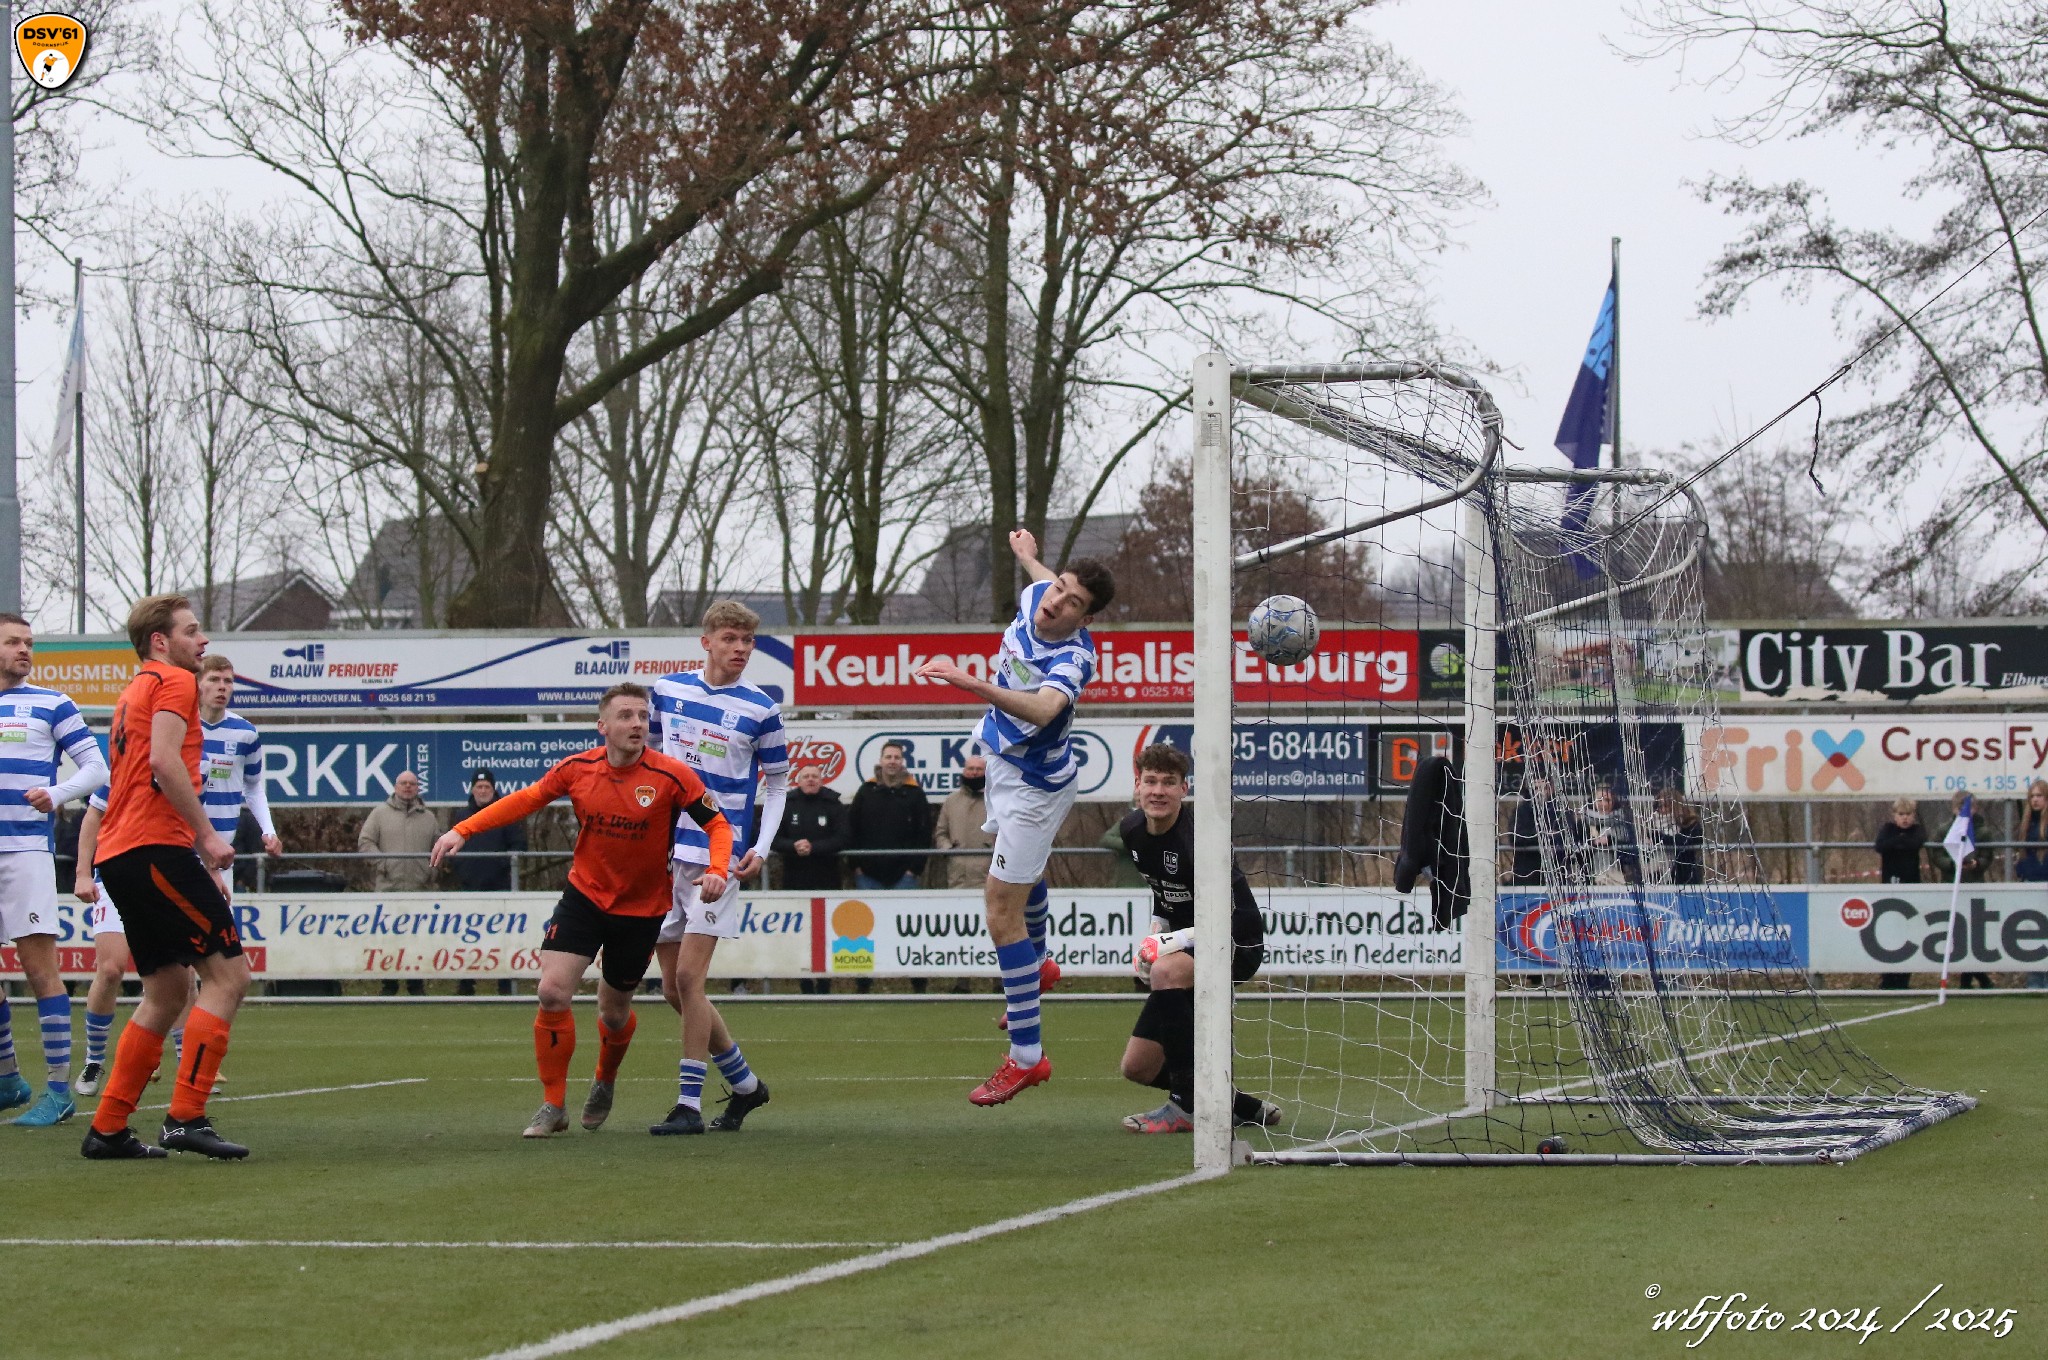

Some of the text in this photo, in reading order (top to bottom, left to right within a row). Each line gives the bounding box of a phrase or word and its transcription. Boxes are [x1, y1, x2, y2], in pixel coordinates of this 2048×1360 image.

[574, 661, 629, 675] BLAAUW
[1746, 631, 1869, 693] City
[1882, 629, 2002, 689] Bar
[269, 663, 399, 678] BLAAUW PERIOVERF
[233, 693, 362, 703] WWW.BLAAUW-PERIOVERF.NL
[378, 693, 399, 702] 0525
[401, 693, 412, 702] 68
[414, 693, 423, 702] 21
[426, 693, 436, 702] 15
[1141, 686, 1169, 697] 0525
[462, 738, 598, 754] Duurzaam gekoeld
[786, 735, 836, 760] ike
[462, 756, 540, 769] drinkwater
[1699, 726, 1866, 792] Frix
[417, 743, 430, 795] WATER
[1924, 776, 1939, 791] T.
[1945, 776, 1967, 791] 06
[1983, 776, 2017, 791] 135
[94, 906, 106, 925] 21
[1843, 907, 1868, 920] ten
[279, 903, 528, 944] Verzekeringen
[218, 925, 240, 948] 14
[363, 948, 423, 972] Tel.:
[432, 947, 501, 972] 0525
[834, 955, 872, 964] MONDA
[1331, 943, 1347, 963] in
[1354, 942, 1462, 964] Nederland
